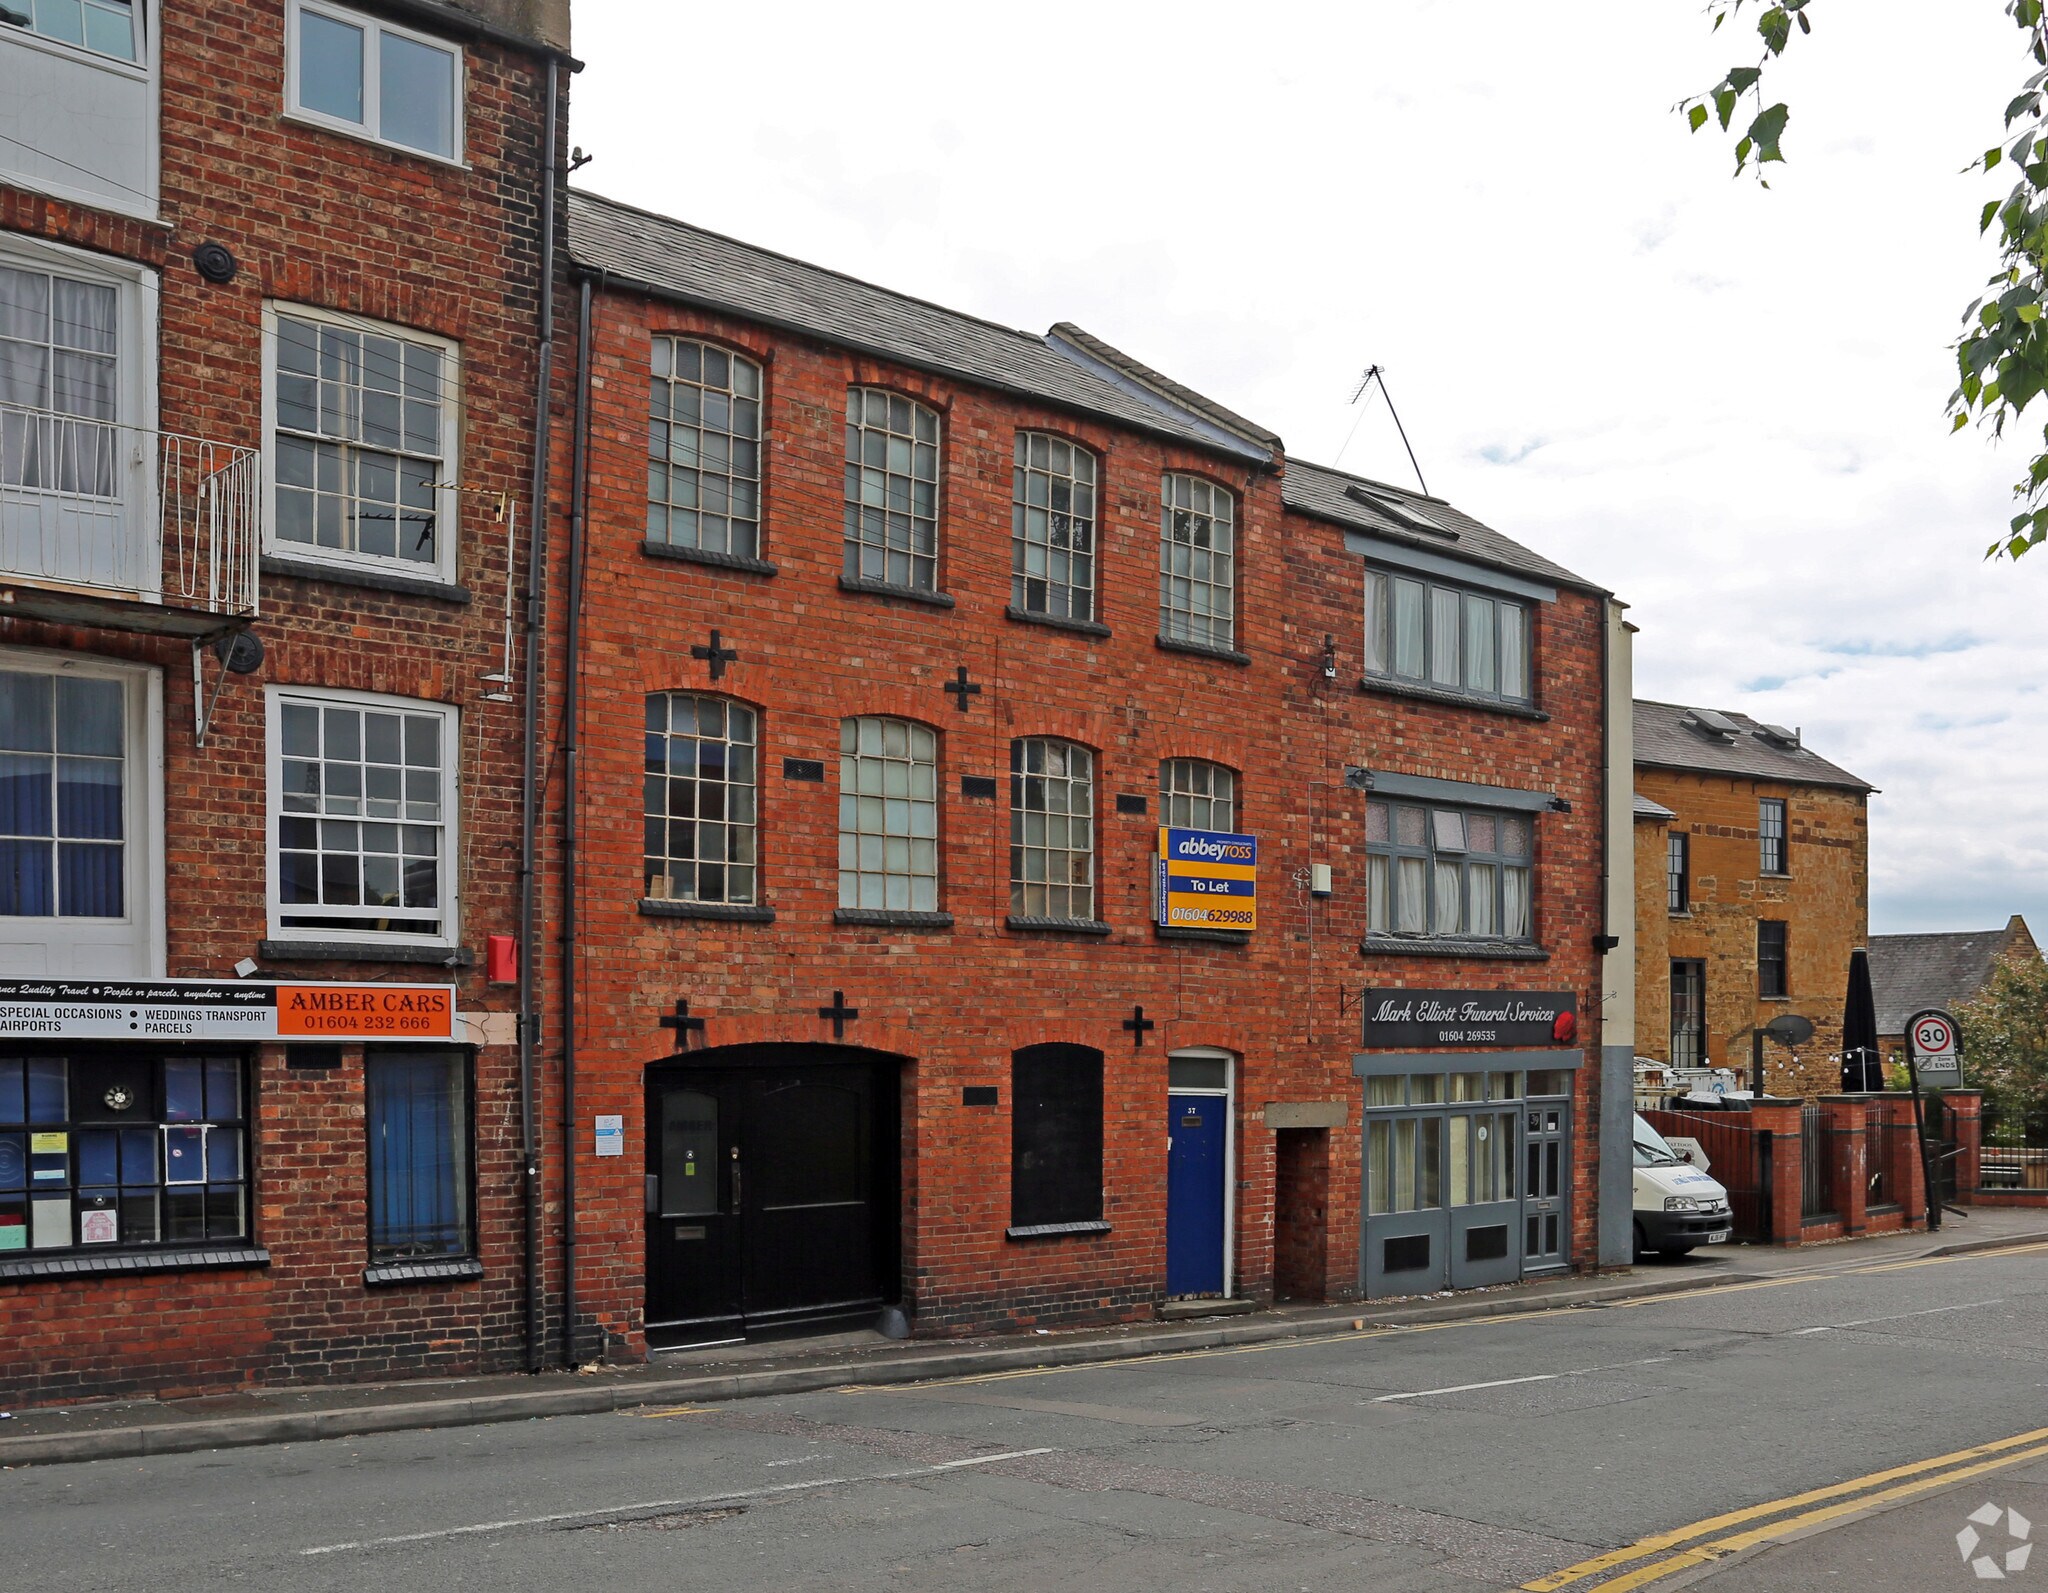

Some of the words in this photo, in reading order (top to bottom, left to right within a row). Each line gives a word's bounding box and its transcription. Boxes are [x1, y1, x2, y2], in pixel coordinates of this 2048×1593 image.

[1179, 837, 1252, 861] abbeyross
[1191, 880, 1205, 892] To
[1209, 881, 1229, 893] Let
[20, 984, 56, 996] Quality
[59, 984, 89, 995] Travel
[103, 986, 133, 997] People
[184, 988, 222, 1000] anywhere
[234, 991, 266, 1001] anytime
[290, 992, 375, 1012] AMBER
[383, 993, 445, 1013] CARS
[0, 1007, 50, 1018] SPECIAL
[54, 1008, 122, 1019] OCCASIONS
[145, 1009, 202, 1020] WEDDINGS
[206, 1010, 267, 1021] TRANSPORT
[1371, 1000, 1412, 1022] Mark
[1416, 1000, 1458, 1022] Elliott
[1459, 1001, 1511, 1022] Funeral
[1509, 1001, 1555, 1022] Services
[0, 1020, 61, 1031] AIRPORTS
[145, 1022, 192, 1033] PARCELS
[304, 1016, 359, 1029] 01604
[364, 1016, 395, 1030] 232
[400, 1017, 430, 1030] 666
[1439, 1031, 1464, 1042] 01604
[1466, 1031, 1496, 1042] 269535
[1920, 1029, 1945, 1042] 30
[1531, 1114, 1540, 1126] 39
